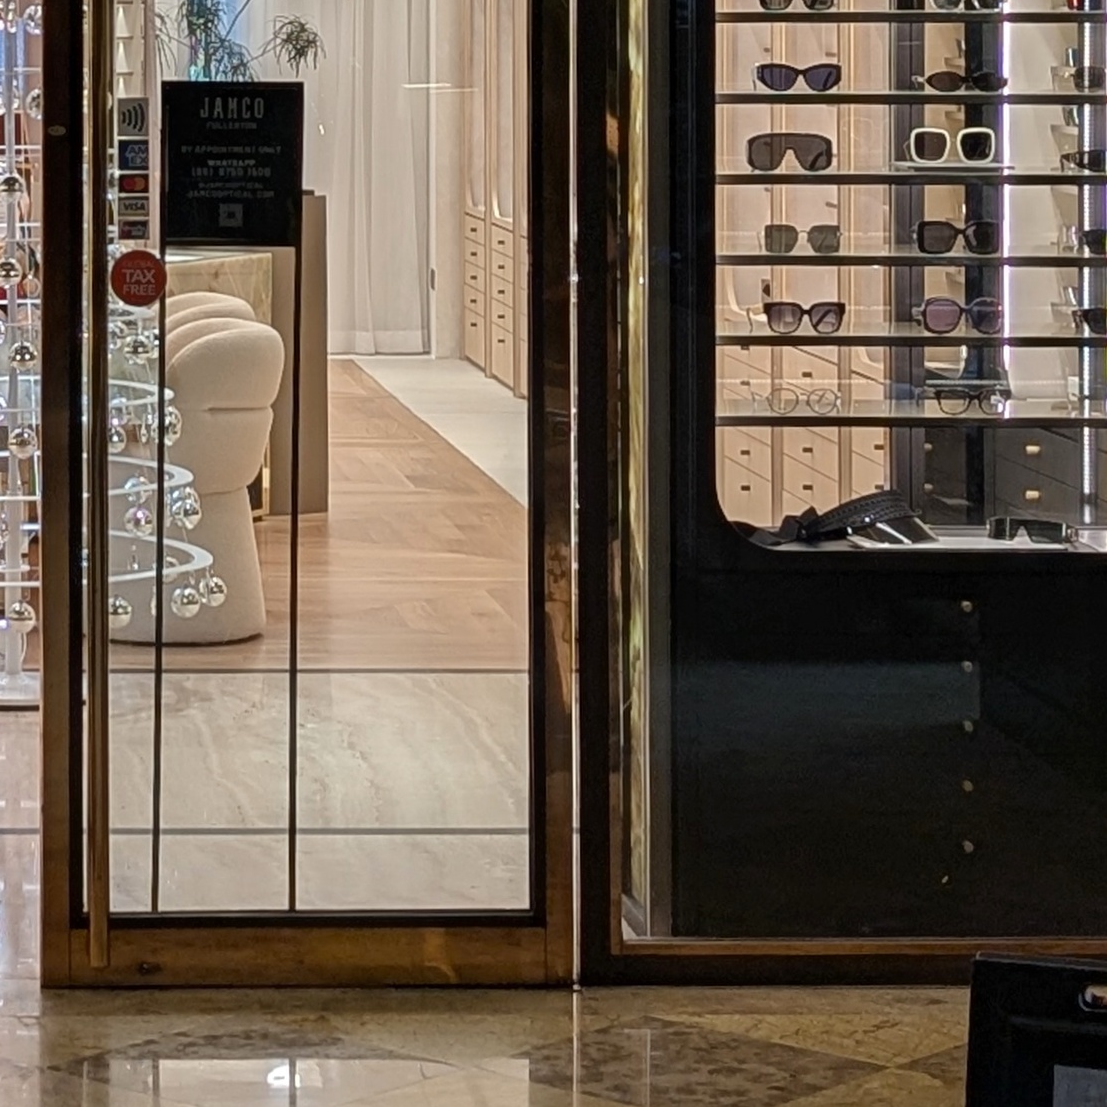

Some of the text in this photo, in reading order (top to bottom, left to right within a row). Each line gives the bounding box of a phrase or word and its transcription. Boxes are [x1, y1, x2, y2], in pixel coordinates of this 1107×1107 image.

[200, 97, 264, 119] JAMCO
[123, 202, 146, 211] VISA
[121, 269, 155, 283] TAX
[122, 284, 156, 295] FREE
